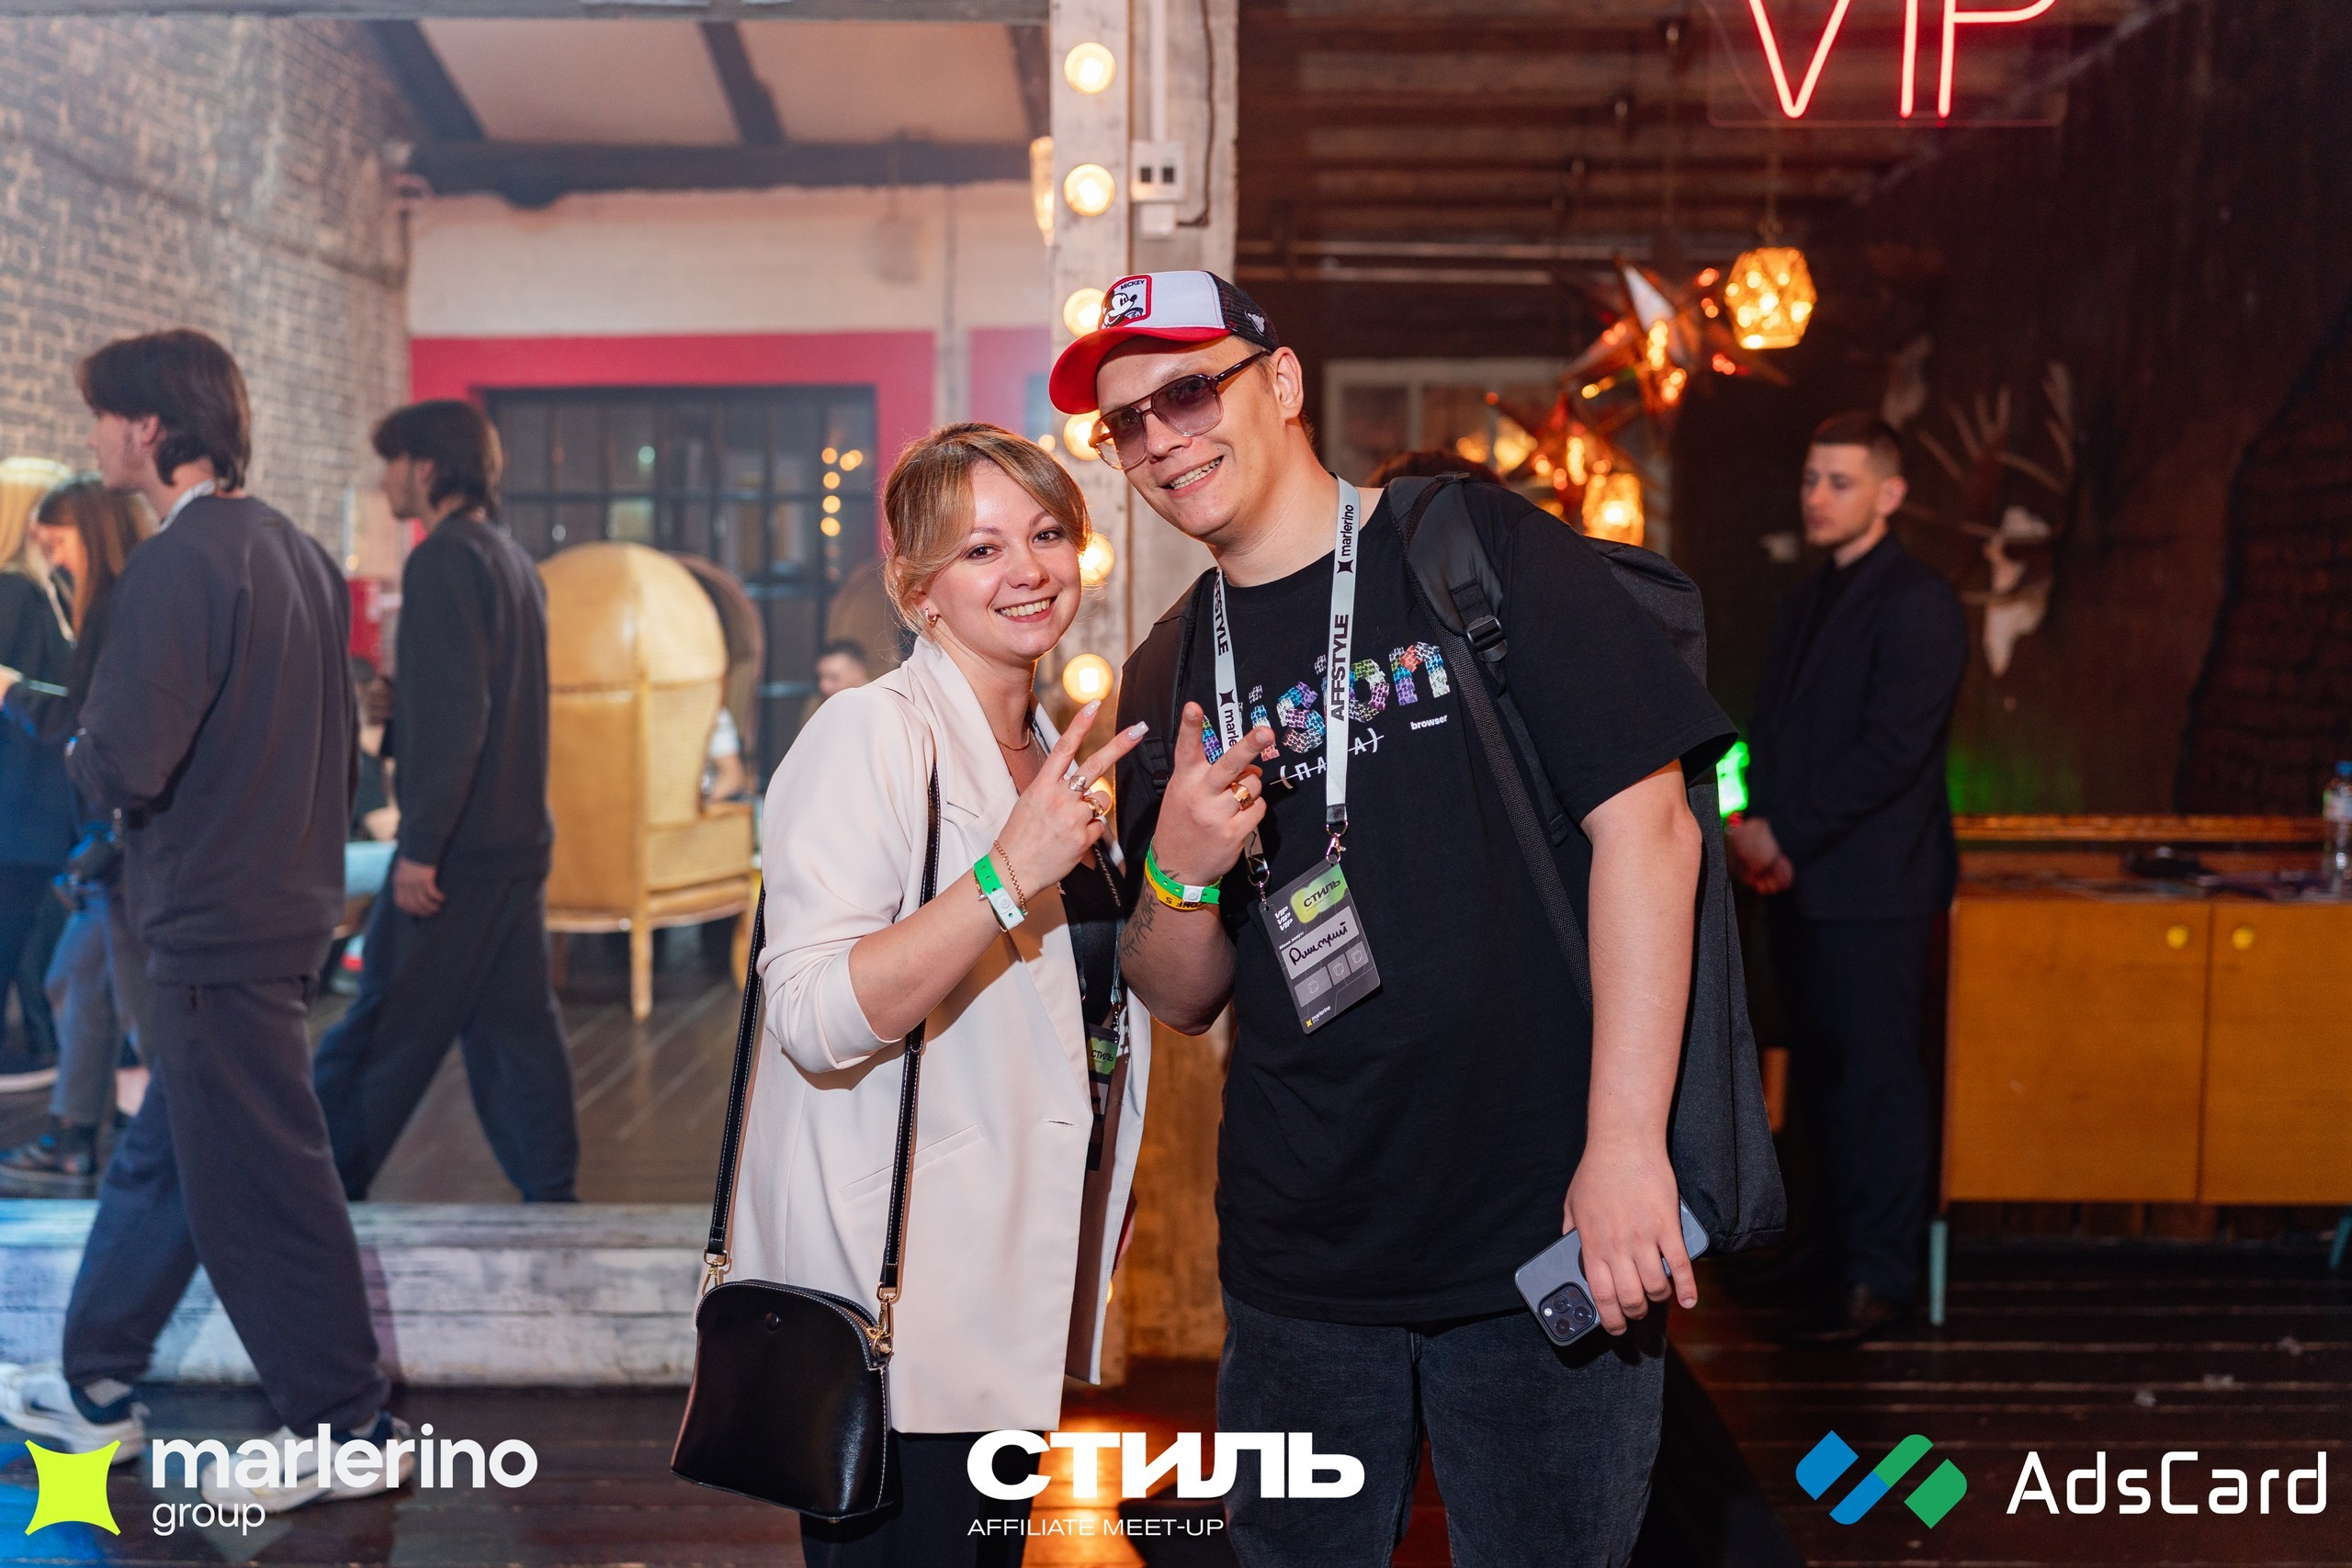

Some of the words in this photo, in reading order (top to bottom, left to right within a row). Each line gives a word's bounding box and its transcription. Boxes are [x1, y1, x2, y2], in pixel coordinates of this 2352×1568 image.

[1748, 0, 2056, 118] VIP
[1120, 279, 1145, 290] MICKEY
[1340, 504, 1354, 557] marlerino
[1330, 614, 1349, 722] AFFSTYLE
[1224, 708, 1241, 748] marle
[1410, 715, 1448, 730] browser
[1303, 879, 1341, 908] СТИЛЬ
[1274, 906, 1288, 919] VIP
[1277, 912, 1291, 925] VIP
[1279, 919, 1293, 931] VIP
[1091, 1049, 1114, 1062] СТИЛЬ
